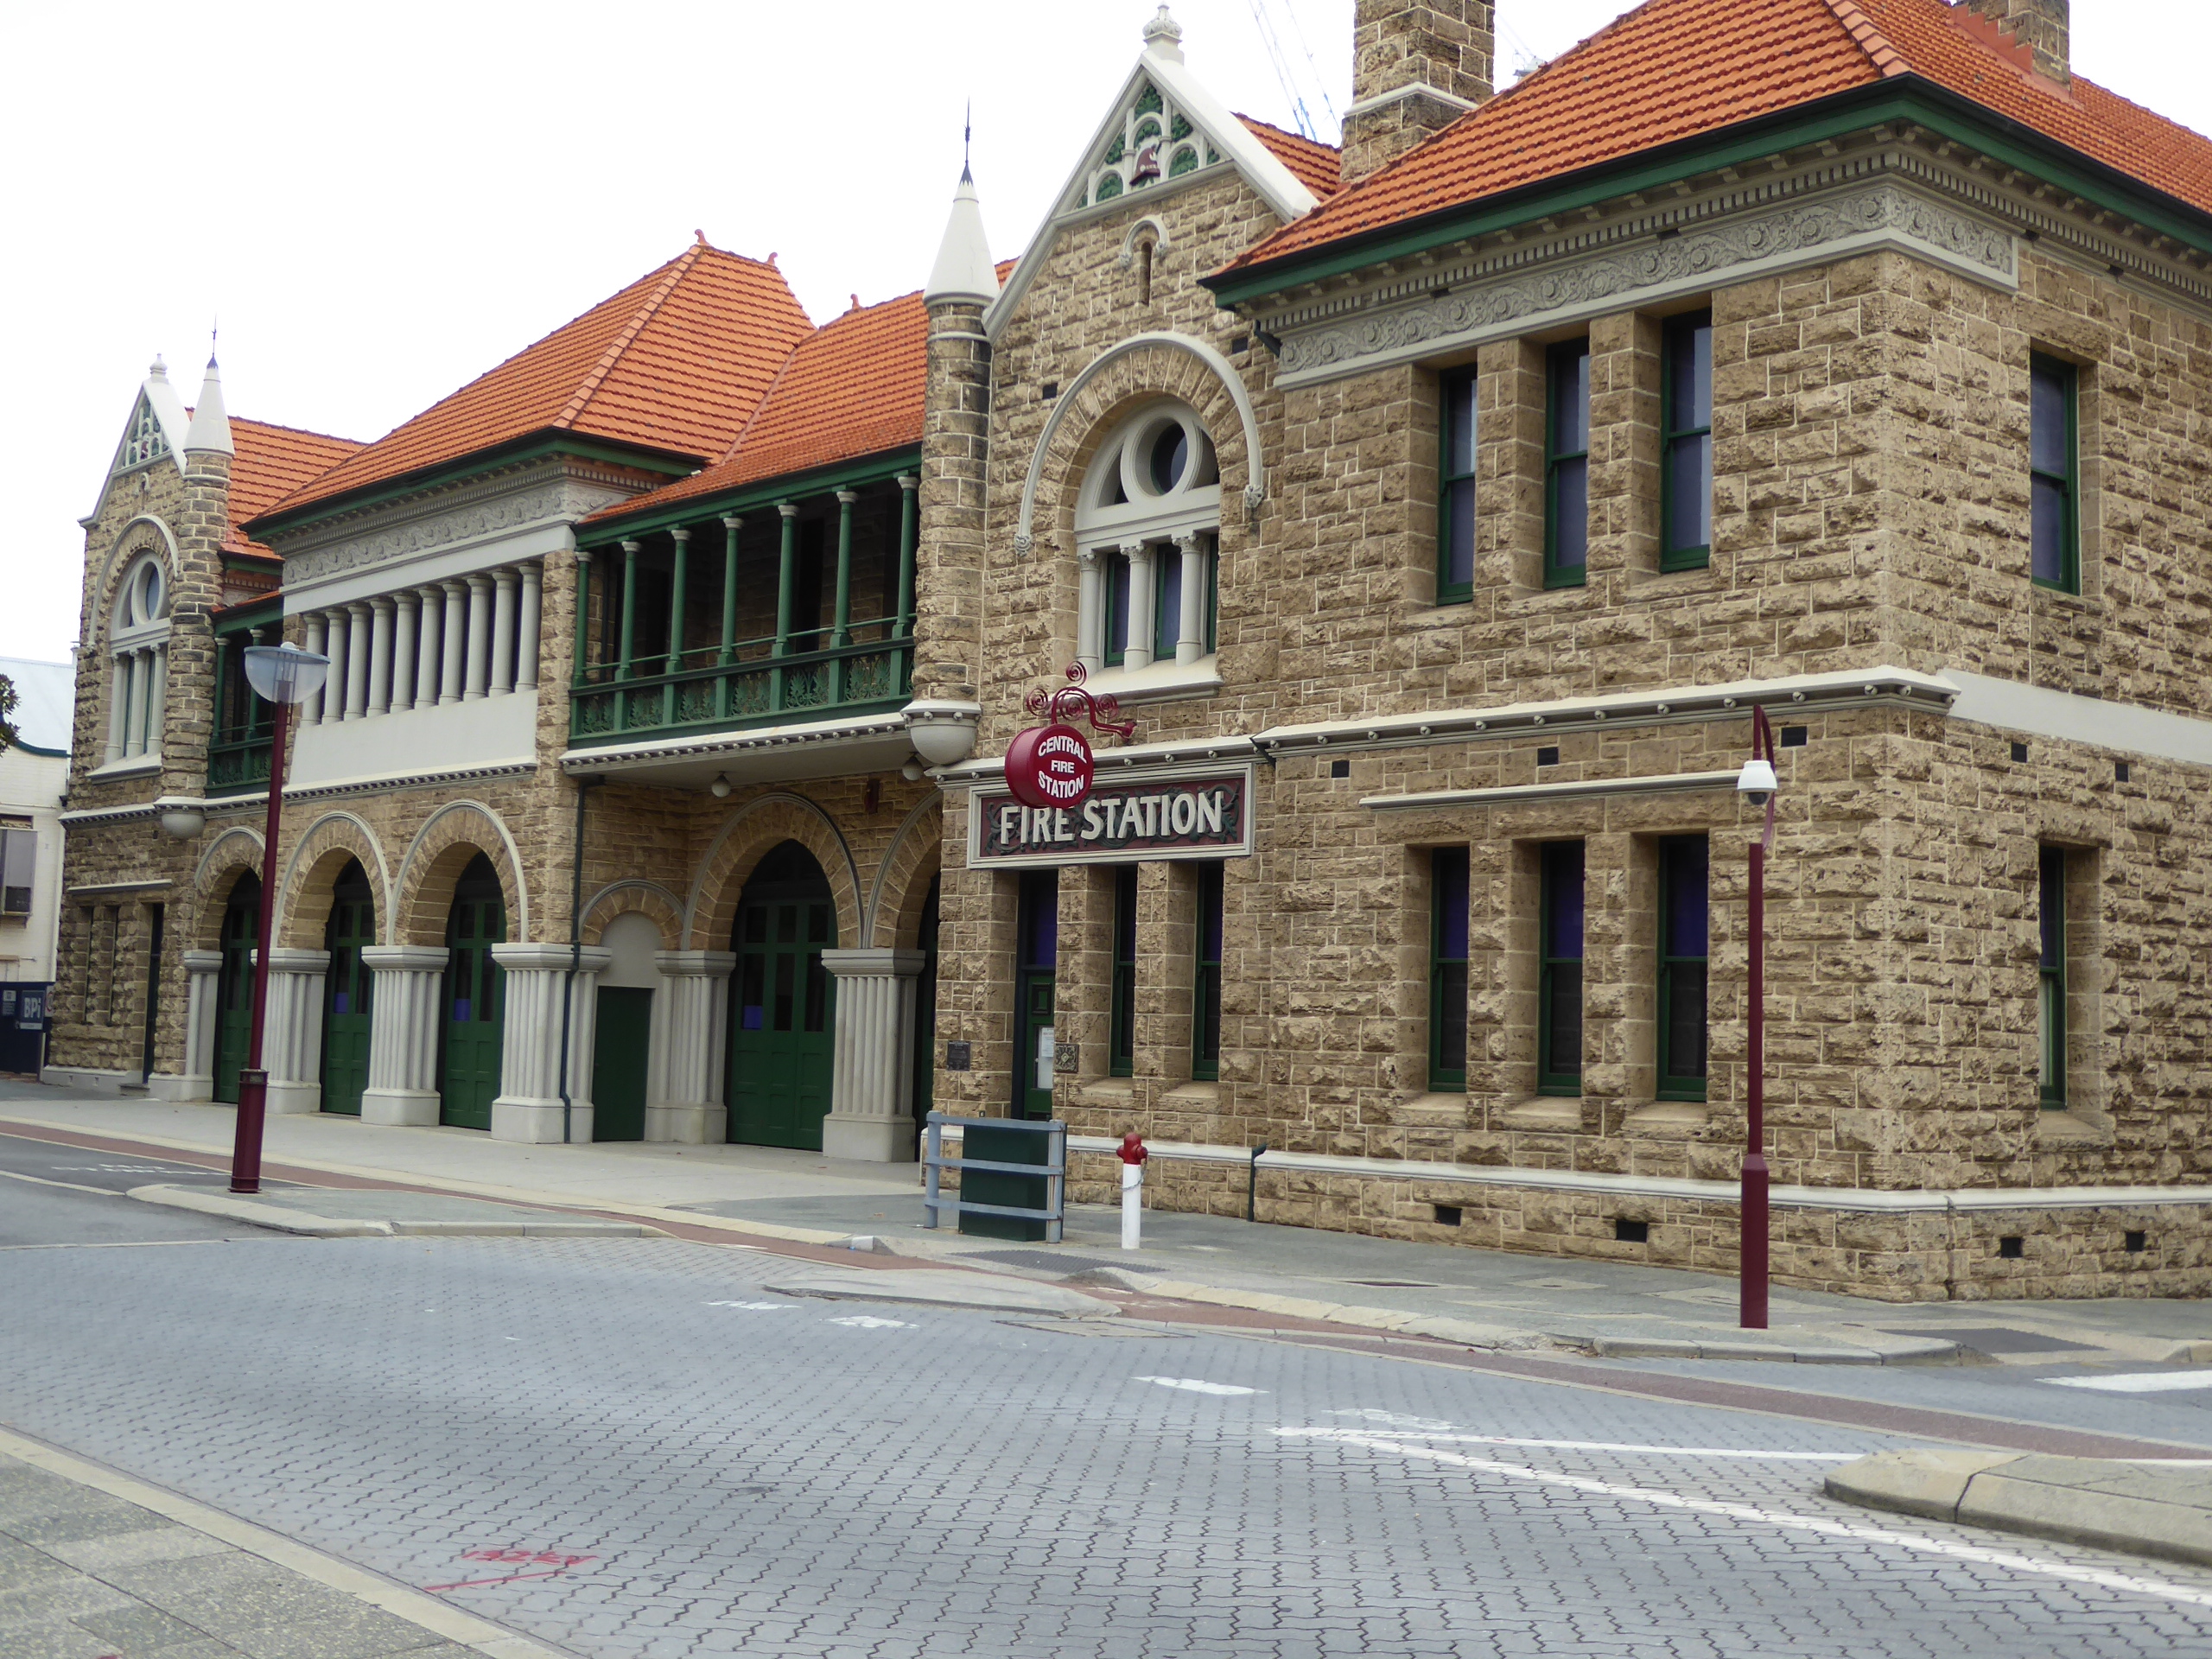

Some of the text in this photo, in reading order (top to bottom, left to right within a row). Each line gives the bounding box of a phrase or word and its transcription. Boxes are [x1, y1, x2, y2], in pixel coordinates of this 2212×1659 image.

[1038, 735, 1087, 764] CENTRAL
[1051, 760, 1075, 774] FIRE
[1038, 770, 1084, 798] STATION
[1001, 791, 1224, 846] FIRE STATION
